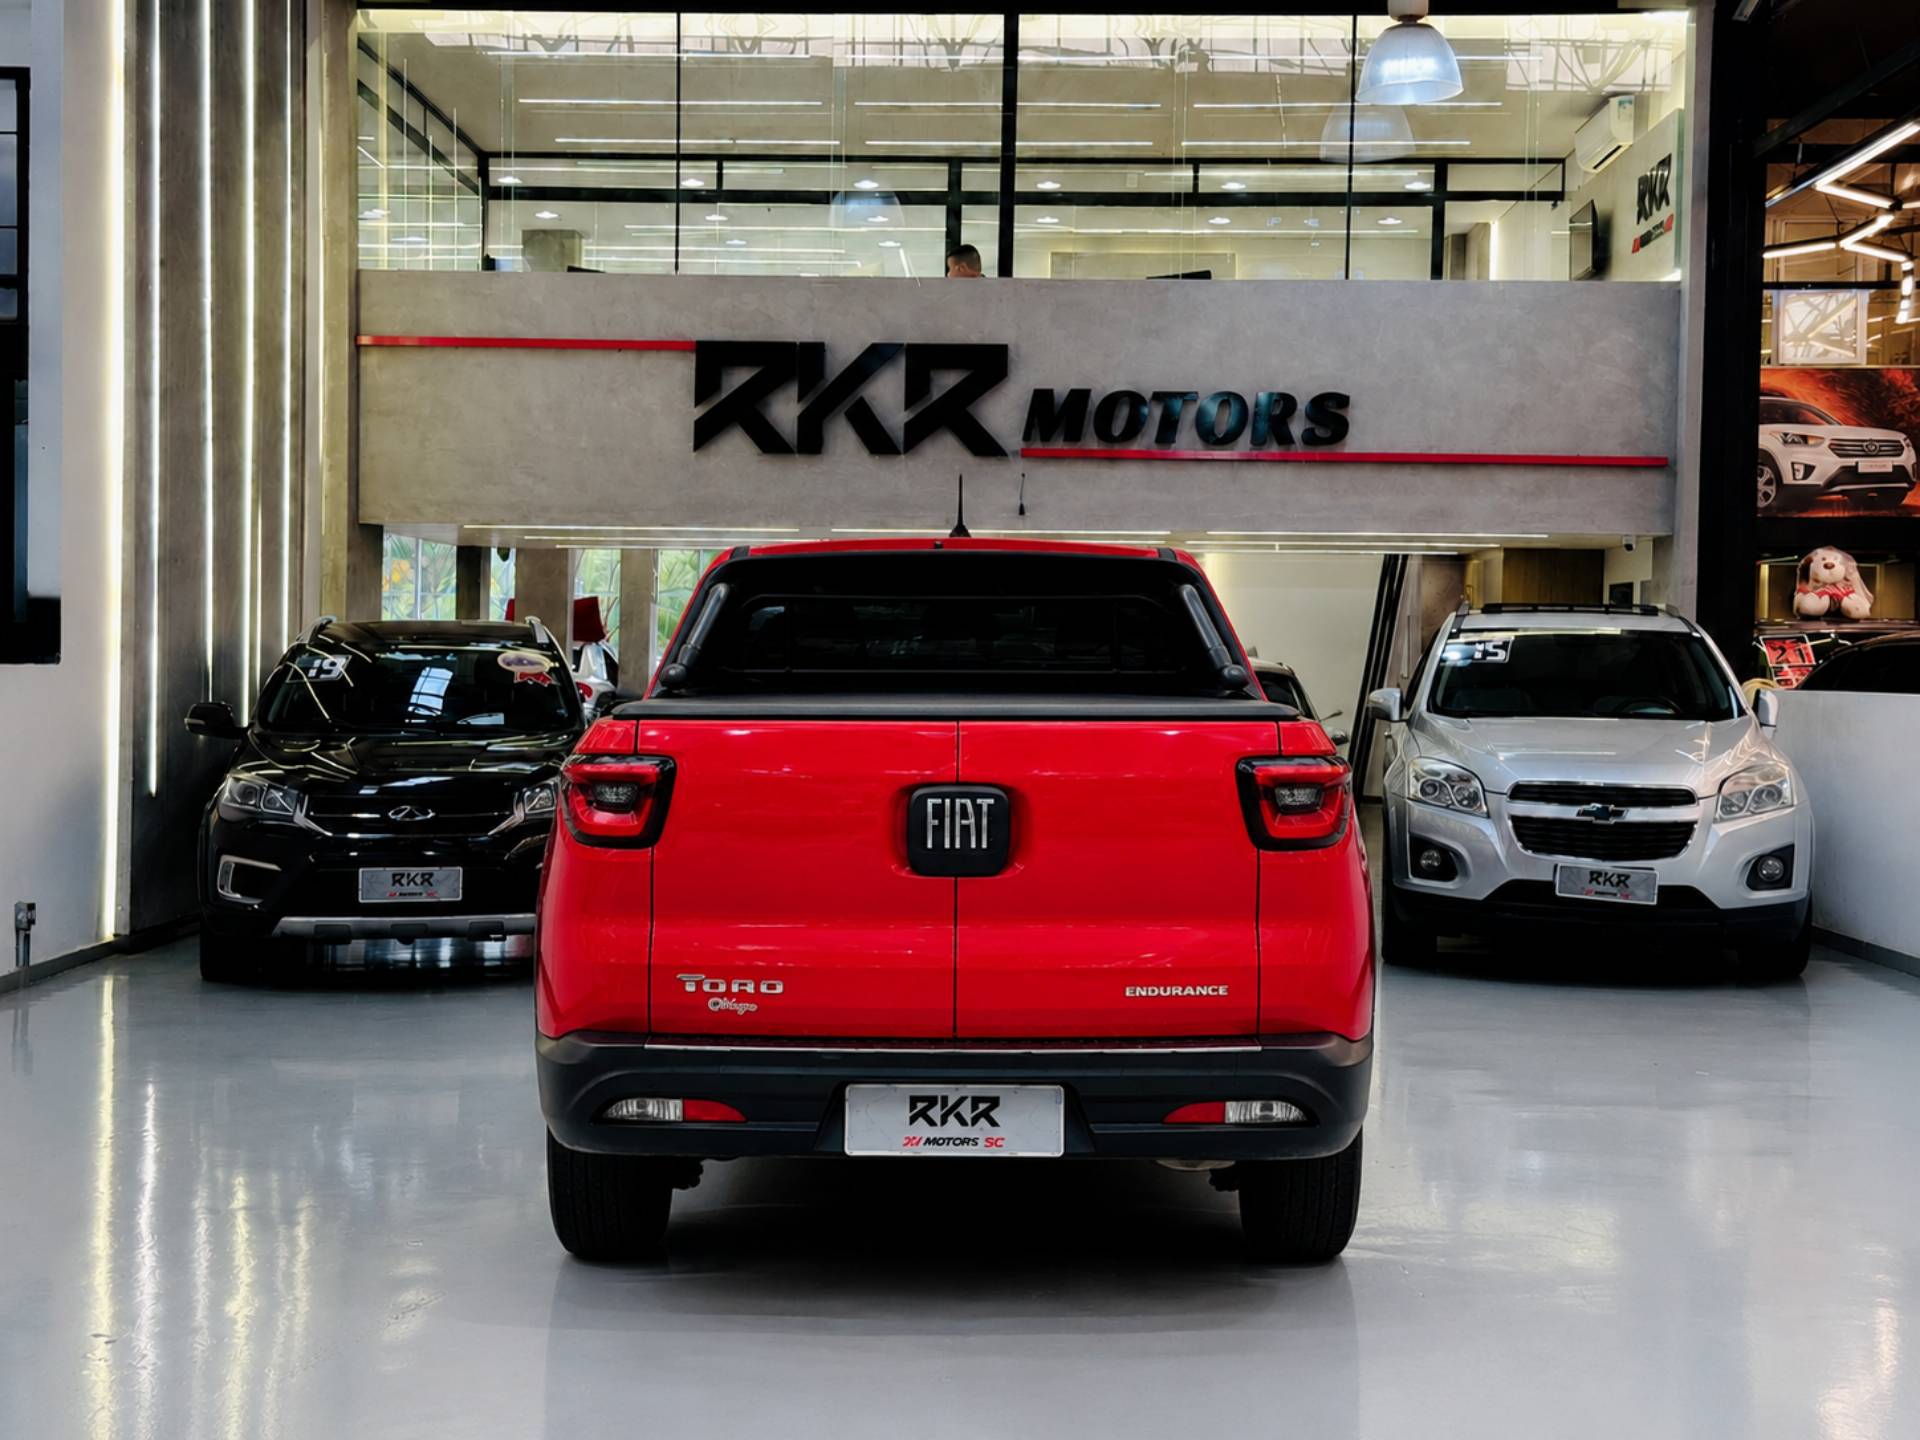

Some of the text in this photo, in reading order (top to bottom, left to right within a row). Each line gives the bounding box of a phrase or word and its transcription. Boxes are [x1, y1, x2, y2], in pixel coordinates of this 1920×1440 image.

[694, 341, 1351, 457] RKR MOTORS
[926, 798, 995, 849] FIAT
[391, 872, 434, 887] RKR
[1589, 870, 1631, 889] RKR
[676, 974, 784, 994] TORO
[1125, 984, 1228, 997] ENDURANCE
[909, 1095, 1001, 1128] RKR
[923, 1136, 1005, 1148] MOTORS SC
